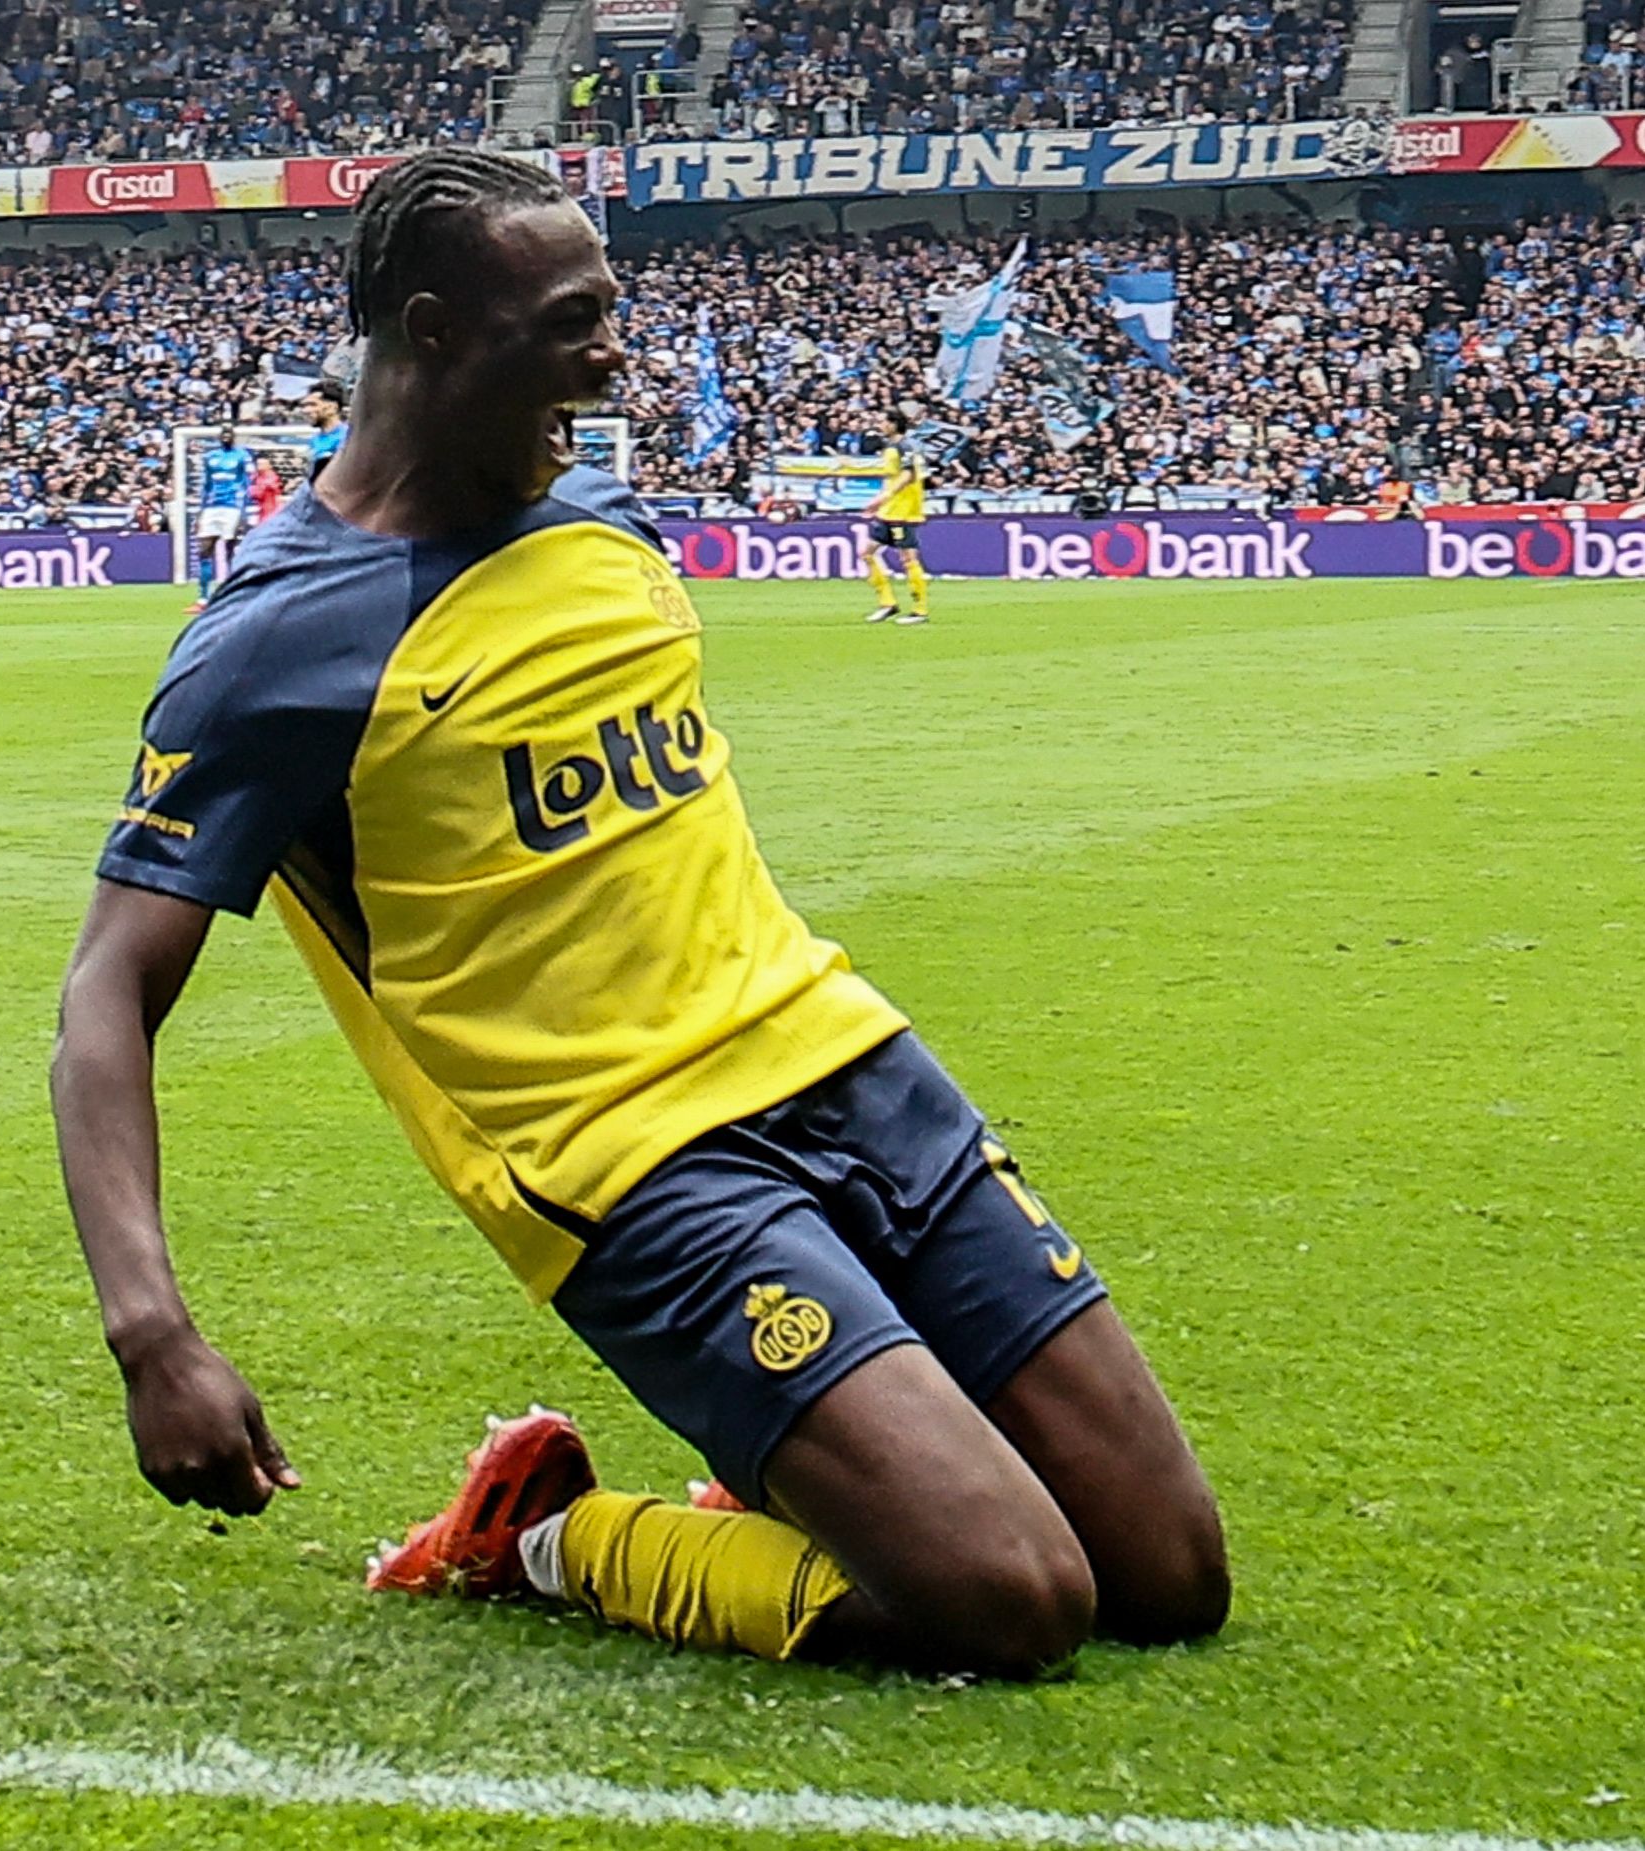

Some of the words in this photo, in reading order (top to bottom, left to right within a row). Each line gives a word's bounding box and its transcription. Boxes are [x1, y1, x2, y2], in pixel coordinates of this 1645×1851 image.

[86, 168, 175, 206] Cristal
[635, 131, 1093, 200] TRIBUNE
[1103, 121, 1337, 185] ZUID
[502, 699, 708, 855] Lotto
